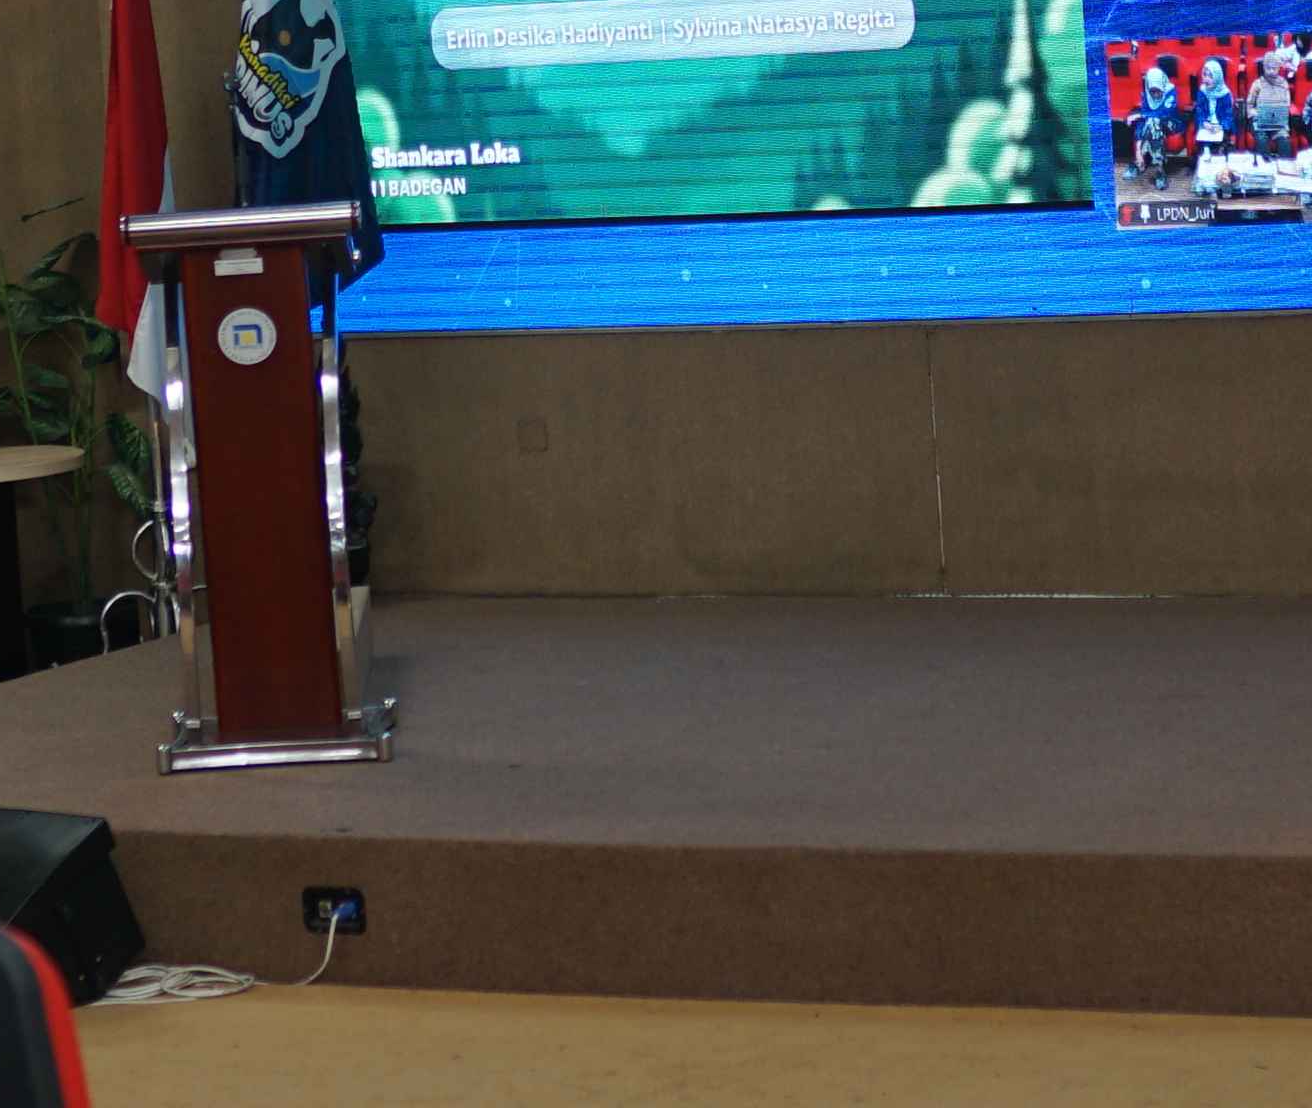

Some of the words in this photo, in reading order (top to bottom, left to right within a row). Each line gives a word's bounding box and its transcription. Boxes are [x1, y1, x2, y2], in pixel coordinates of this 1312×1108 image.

[446, 28, 487, 50] Erlin
[494, 24, 556, 48] Desika
[561, 19, 653, 47] Hadiyanti
[673, 14, 742, 44] Sylvina
[747, 11, 828, 36] Natasya
[833, 8, 896, 35] Regita
[371, 144, 467, 169] Shankara
[470, 141, 521, 165] Loka
[1157, 203, 1216, 222] LPDN_Juri
